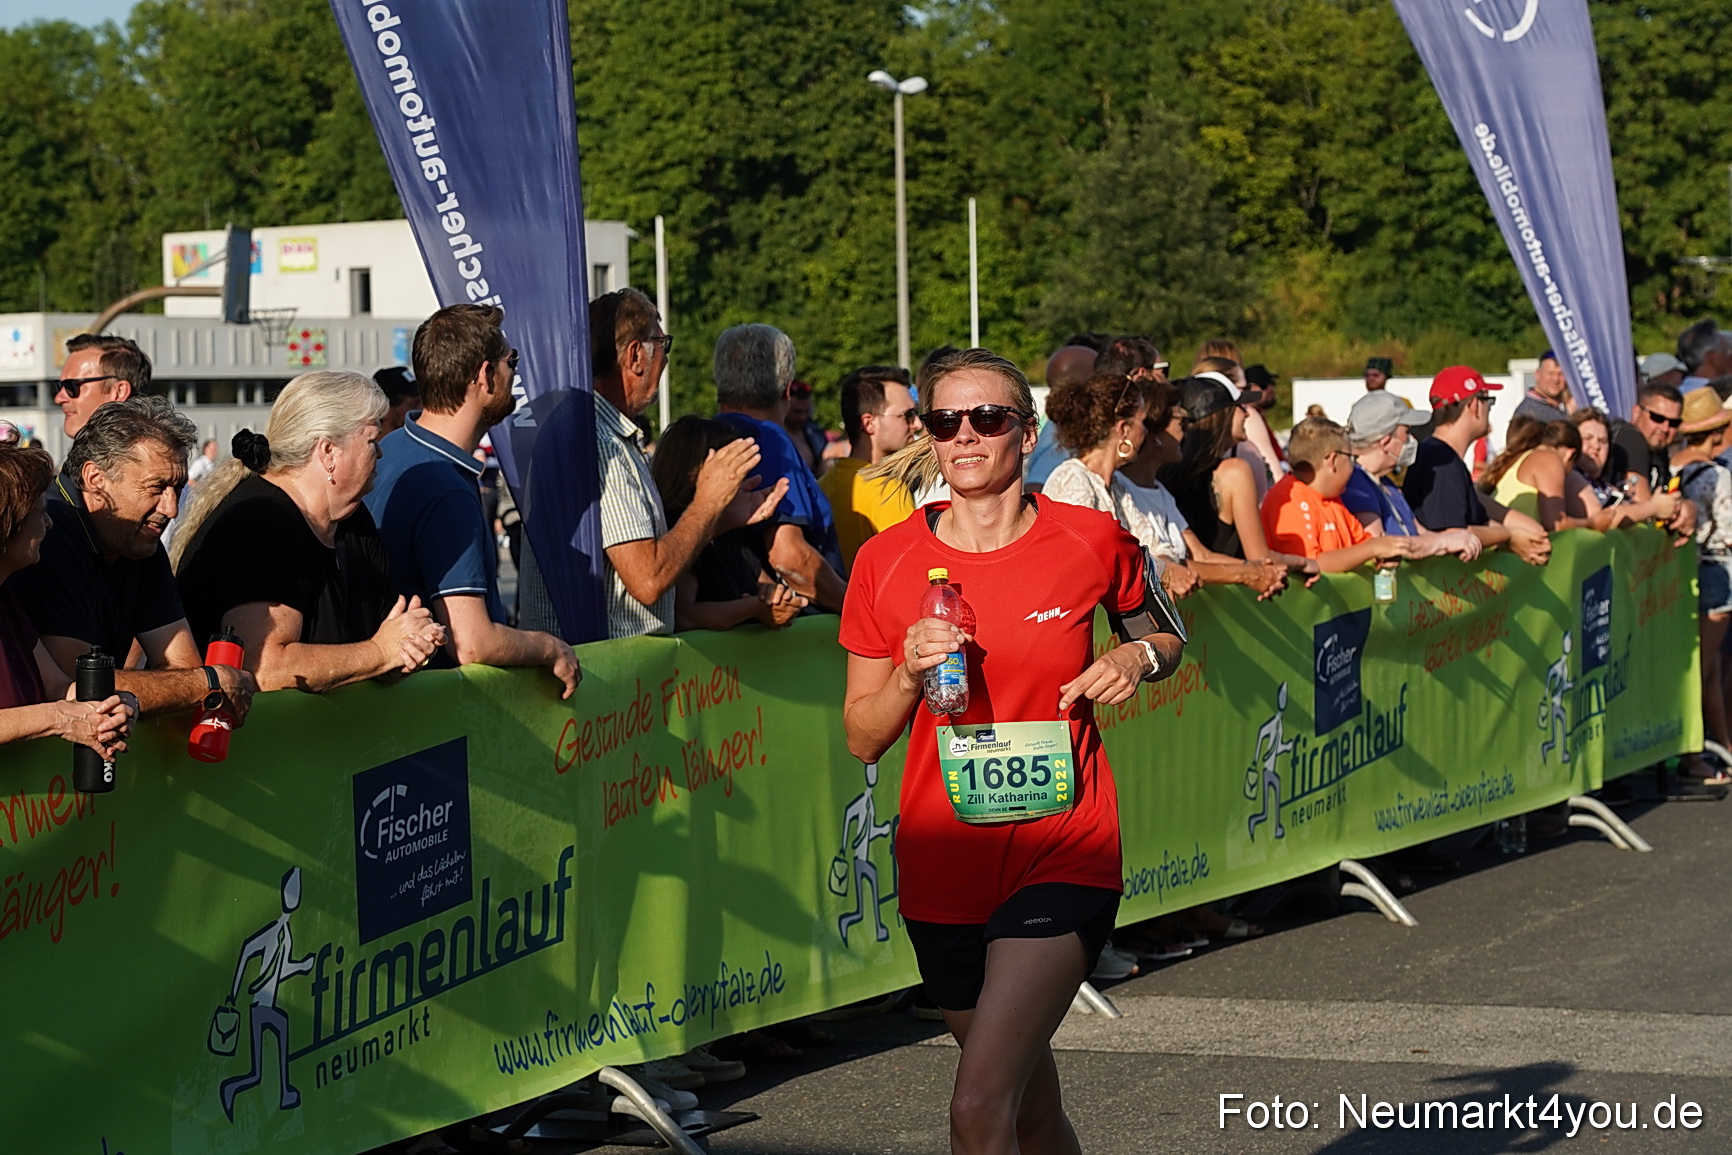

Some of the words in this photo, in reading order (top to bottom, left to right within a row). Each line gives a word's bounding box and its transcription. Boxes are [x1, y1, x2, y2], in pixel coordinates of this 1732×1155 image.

[1037, 606, 1061, 623] DEHN
[555, 677, 655, 774] Gesunde
[661, 664, 742, 726] Firmen
[1291, 682, 1408, 799] firmenlauf
[971, 740, 1012, 751] Firmenlauf
[603, 752, 679, 830] laufen
[682, 706, 767, 798] länger!
[948, 771, 961, 804] RUN
[961, 755, 1052, 790] 1685
[1054, 759, 1068, 802] 2022
[967, 794, 985, 805] Zill
[988, 790, 1048, 804] Katharina
[1291, 781, 1347, 827] neumarkt
[377, 800, 453, 848] Fischer
[385, 829, 449, 864] AUTOMOBILE
[311, 844, 575, 1047] firmenlauf
[315, 1005, 431, 1089] neumarkt
